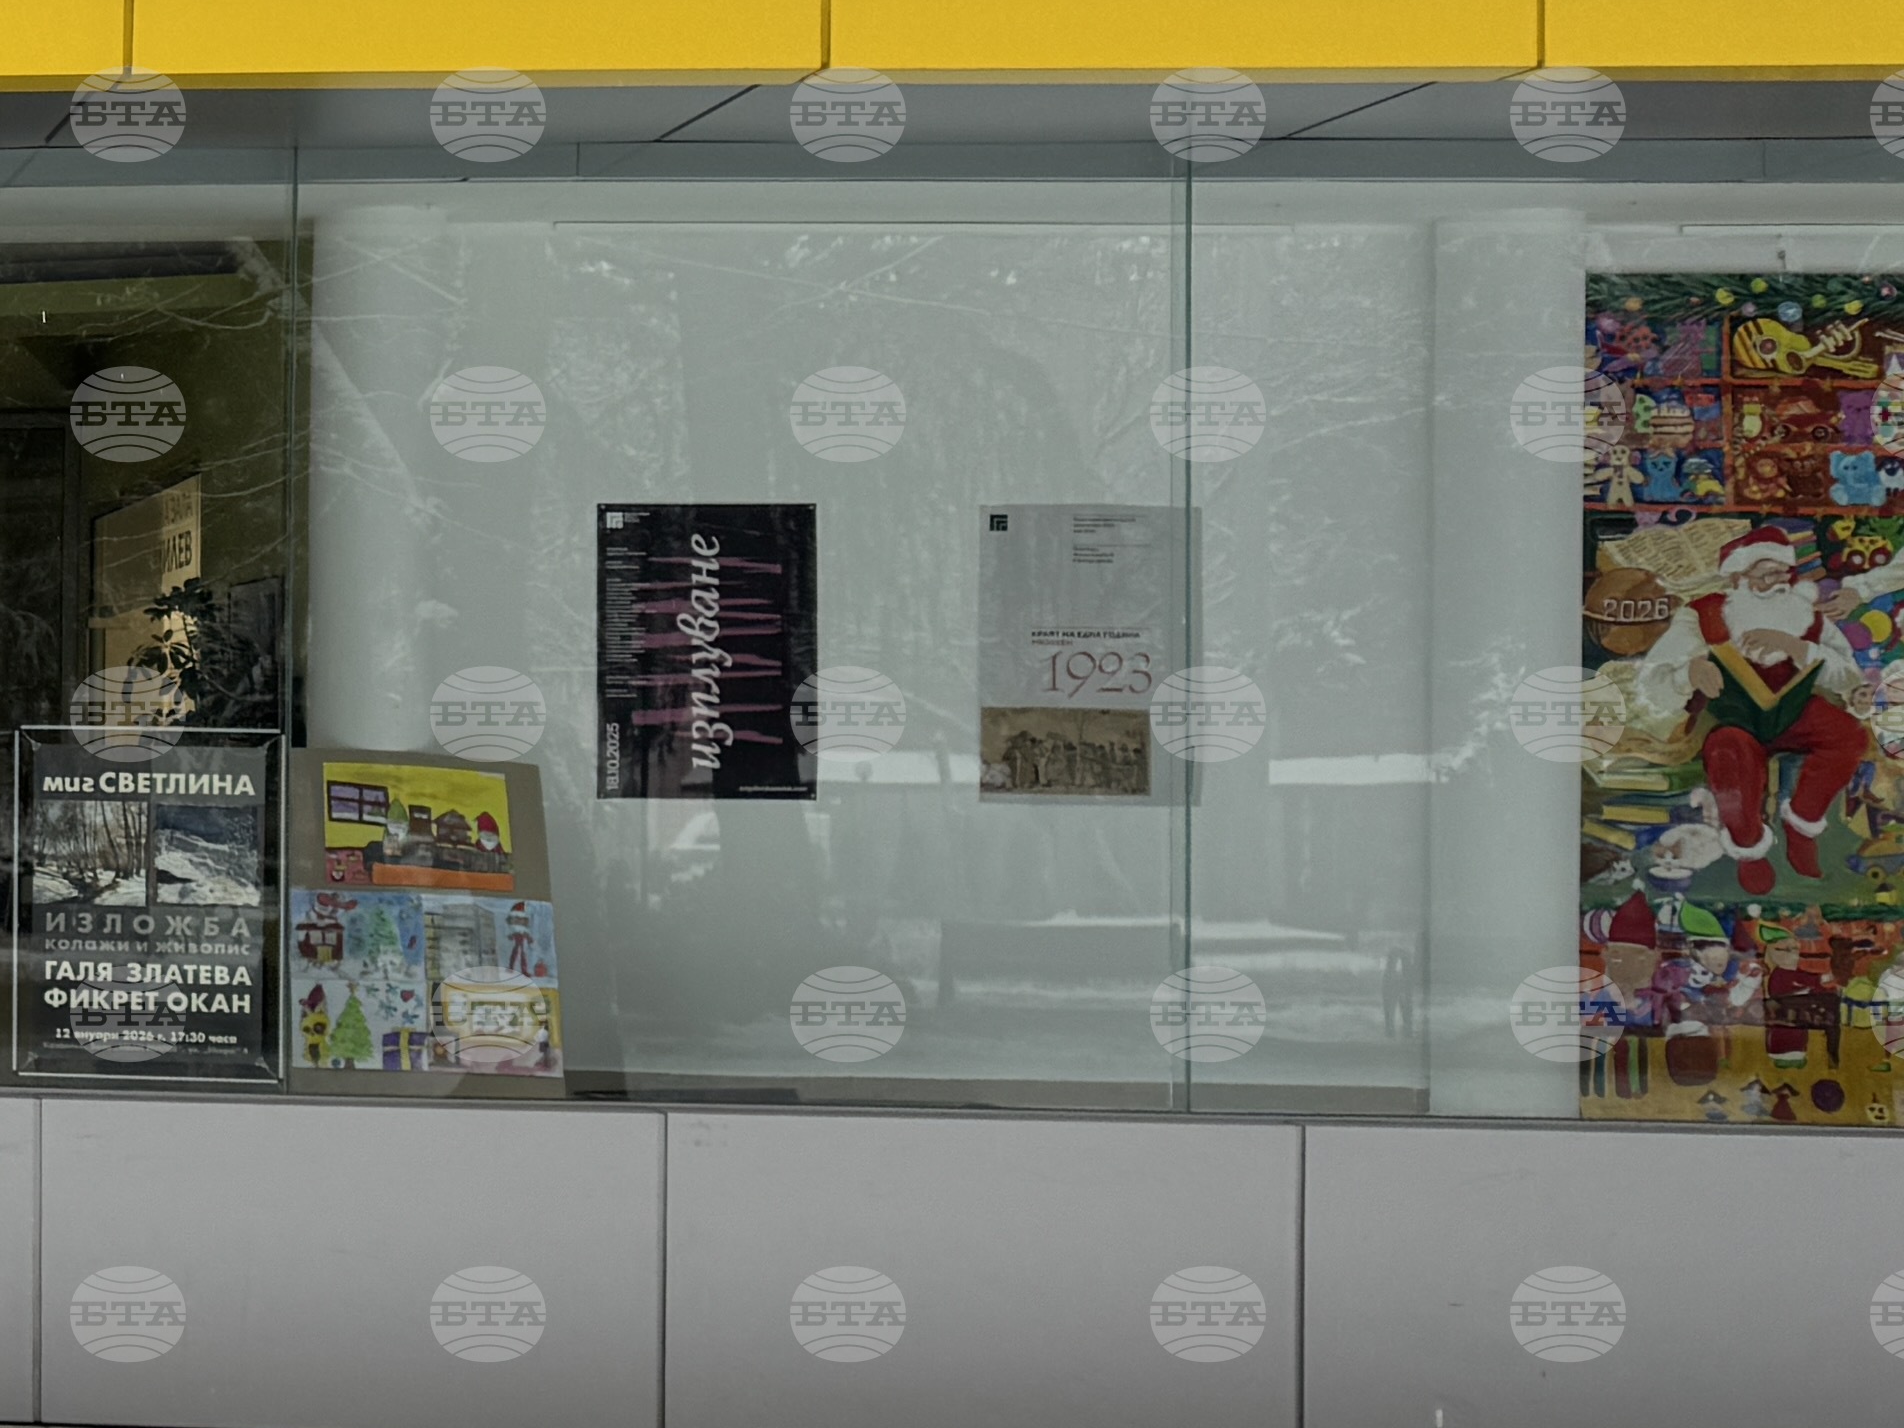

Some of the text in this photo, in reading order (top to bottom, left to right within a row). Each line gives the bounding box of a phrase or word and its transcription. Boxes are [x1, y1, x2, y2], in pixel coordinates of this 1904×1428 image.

[1602, 597, 1671, 623] 2026
[1044, 650, 1152, 698] 1923
[99, 772, 256, 797] СВЕТЛИНА
[45, 912, 251, 937] ИЗЛОЖБА
[44, 960, 252, 986] ГАЛЯ ЗЛАТЕВА
[44, 987, 251, 1014] ФИКРЕТ ОКАН
[55, 1028, 71, 1039] 12
[122, 1030, 154, 1041] 2026
[170, 1031, 206, 1043] 17:30
